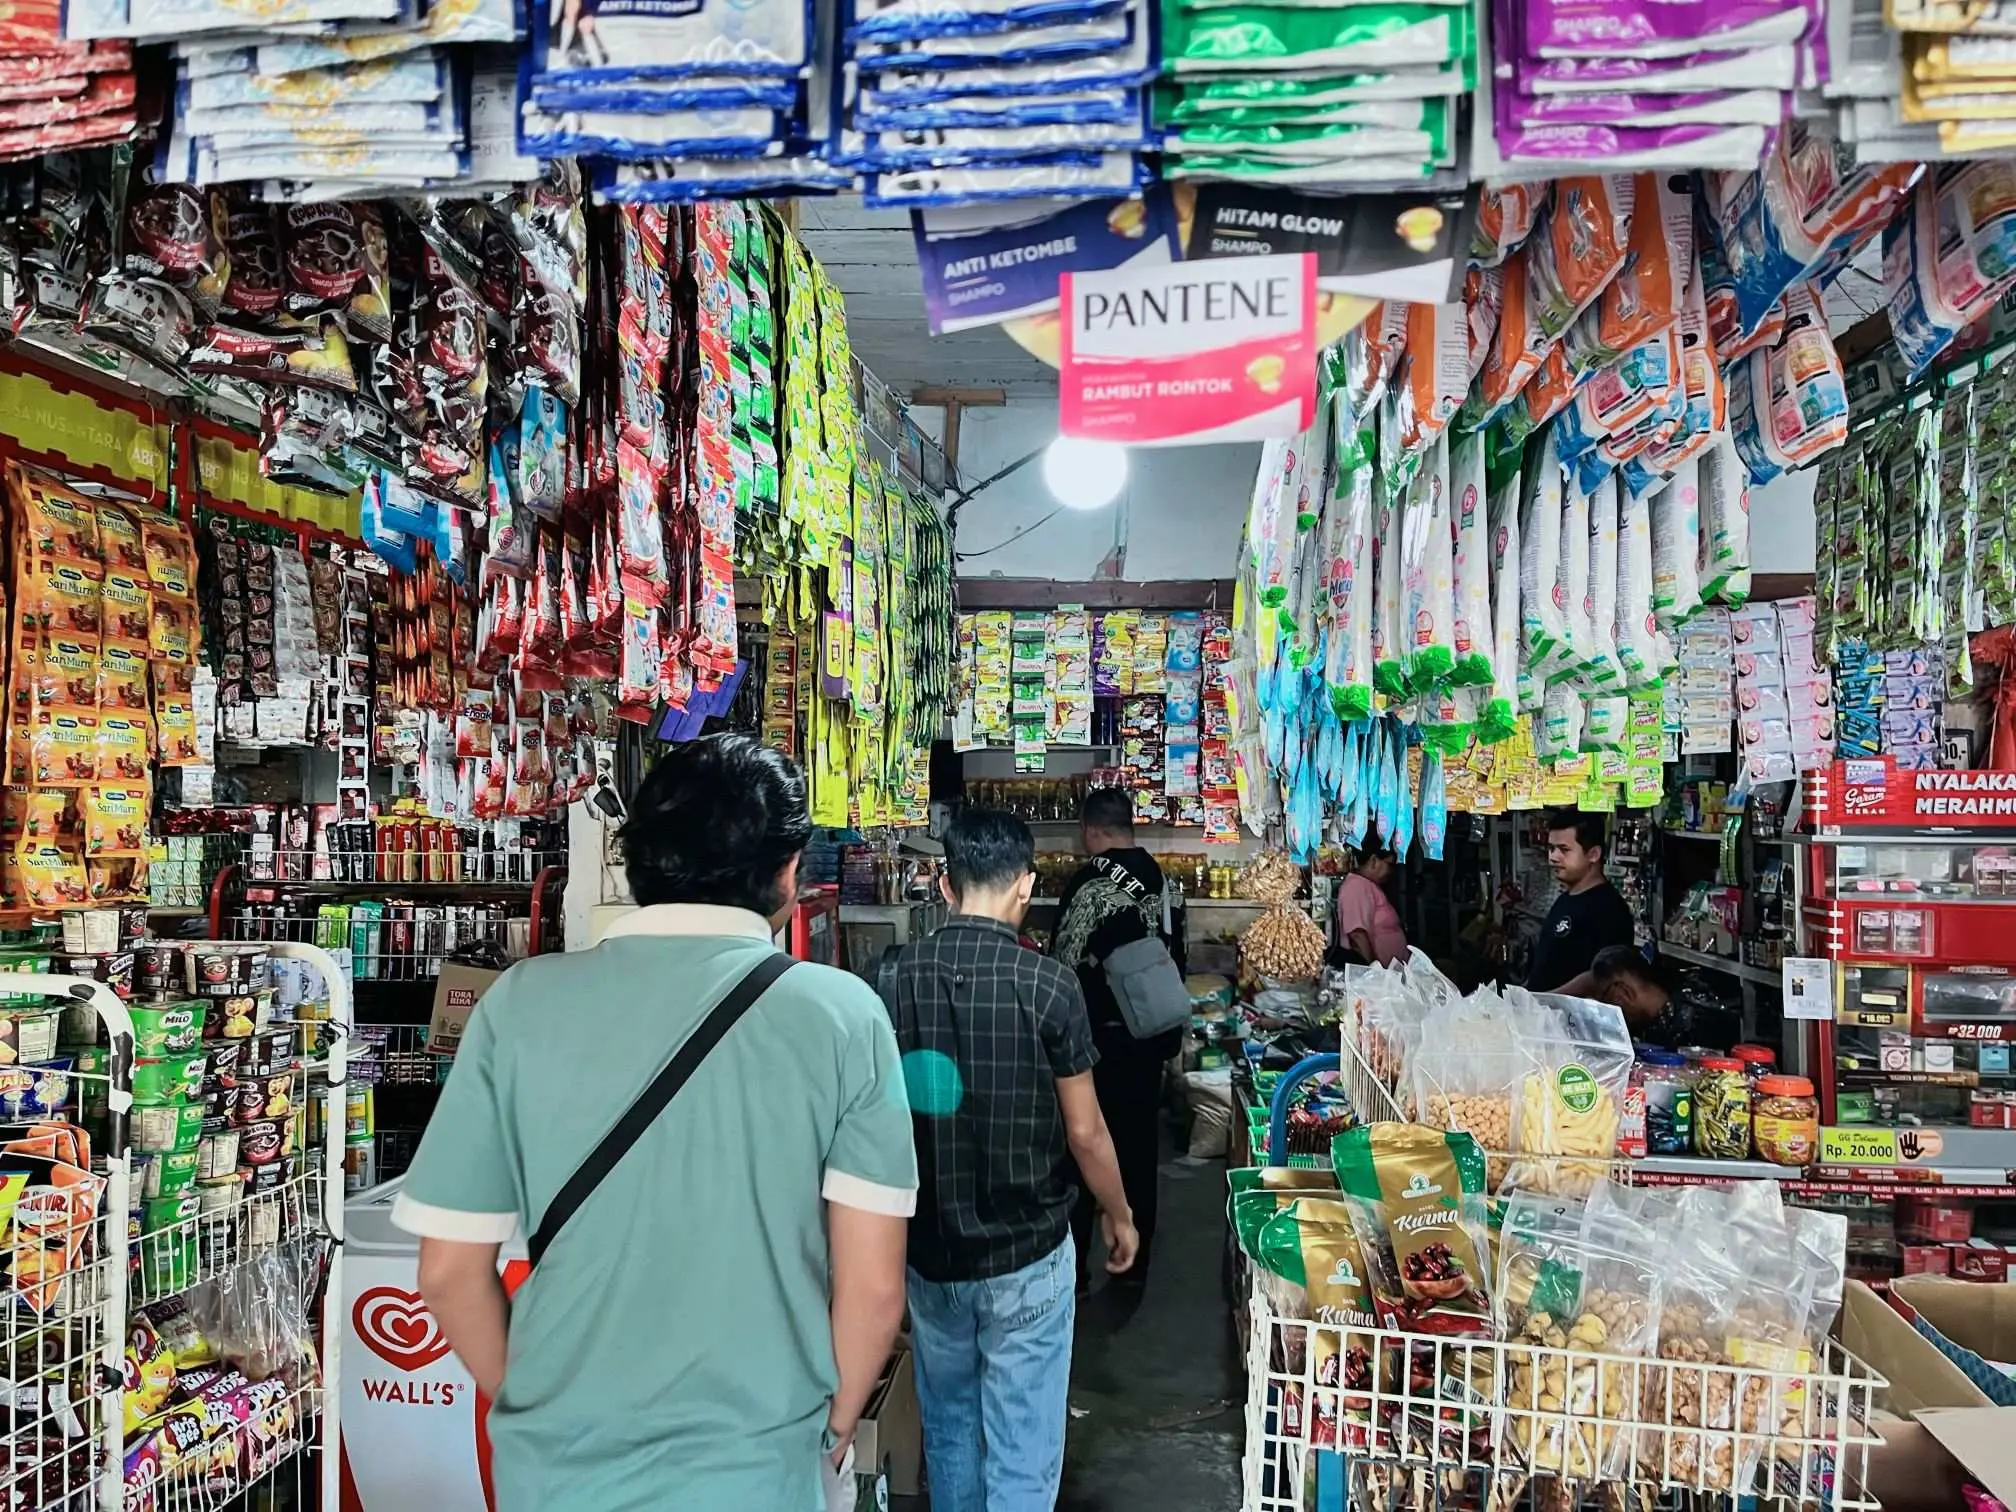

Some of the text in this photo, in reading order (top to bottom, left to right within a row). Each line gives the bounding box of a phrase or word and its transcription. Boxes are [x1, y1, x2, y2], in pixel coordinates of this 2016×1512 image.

[1282, 215, 1344, 237] GLOW
[1211, 237, 1272, 255] SHAMPO
[944, 237, 1077, 279] ANTI KETOMBE
[948, 283, 1006, 305] SHAMPO
[1081, 276, 1291, 332] PANTENE
[1082, 380, 1154, 403] RAMBUT
[1157, 375, 1233, 397] RONTOK
[450, 990, 471, 998] TORA
[165, 1016, 190, 1025] MILO
[1826, 1144, 1893, 1158] Rp. 20.000
[1393, 1208, 1459, 1232] Kurma
[1315, 1304, 1376, 1328] Kurma
[362, 1378, 455, 1406] WALL'S
